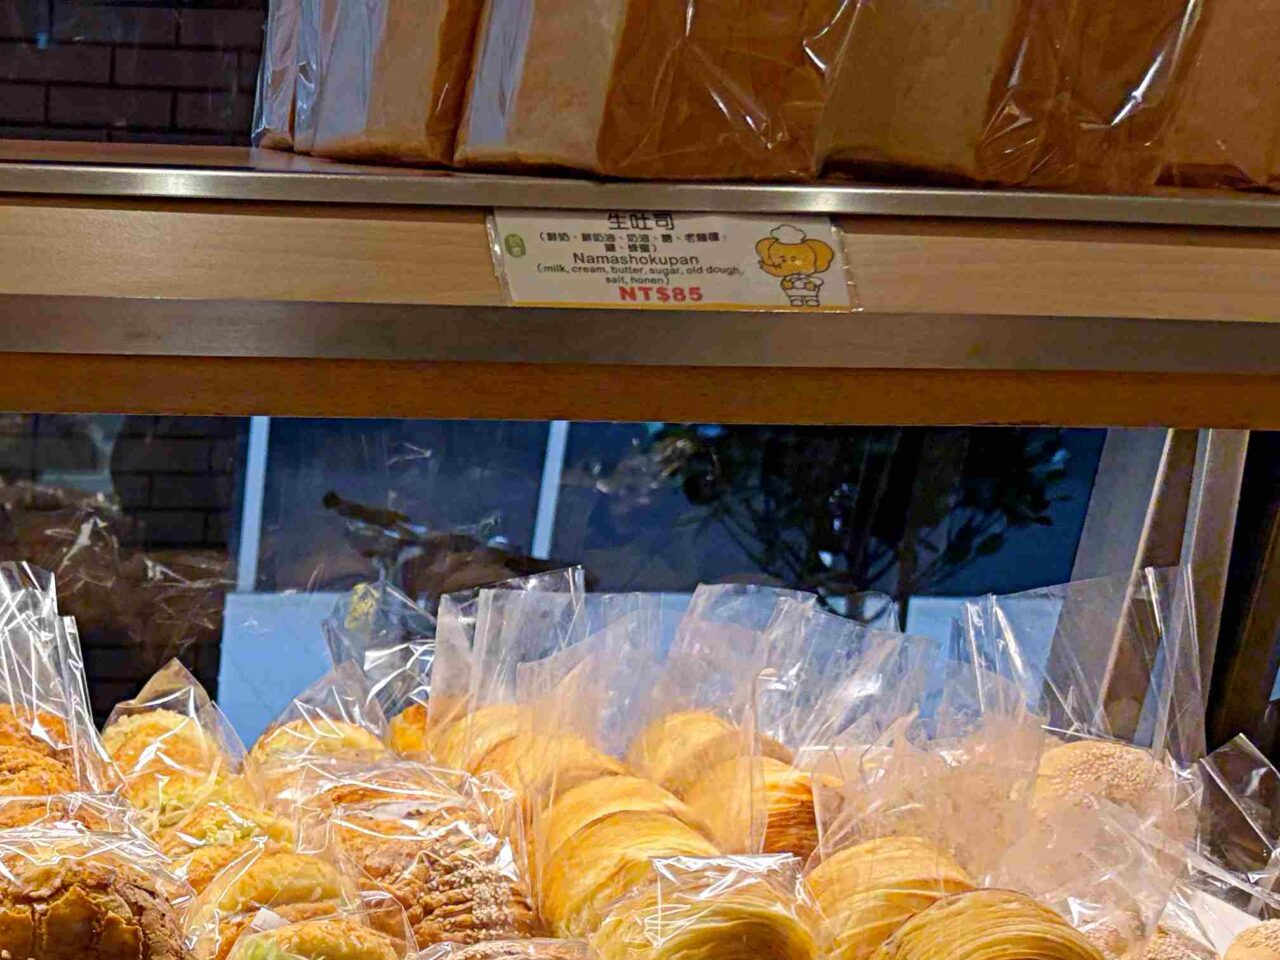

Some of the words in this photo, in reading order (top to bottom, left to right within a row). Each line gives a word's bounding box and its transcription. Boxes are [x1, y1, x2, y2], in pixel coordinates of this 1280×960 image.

[607, 213, 675, 231] 生吐司
[573, 252, 699, 266] Namashokupan
[686, 265, 703, 275] old
[619, 286, 703, 302] NT$85
